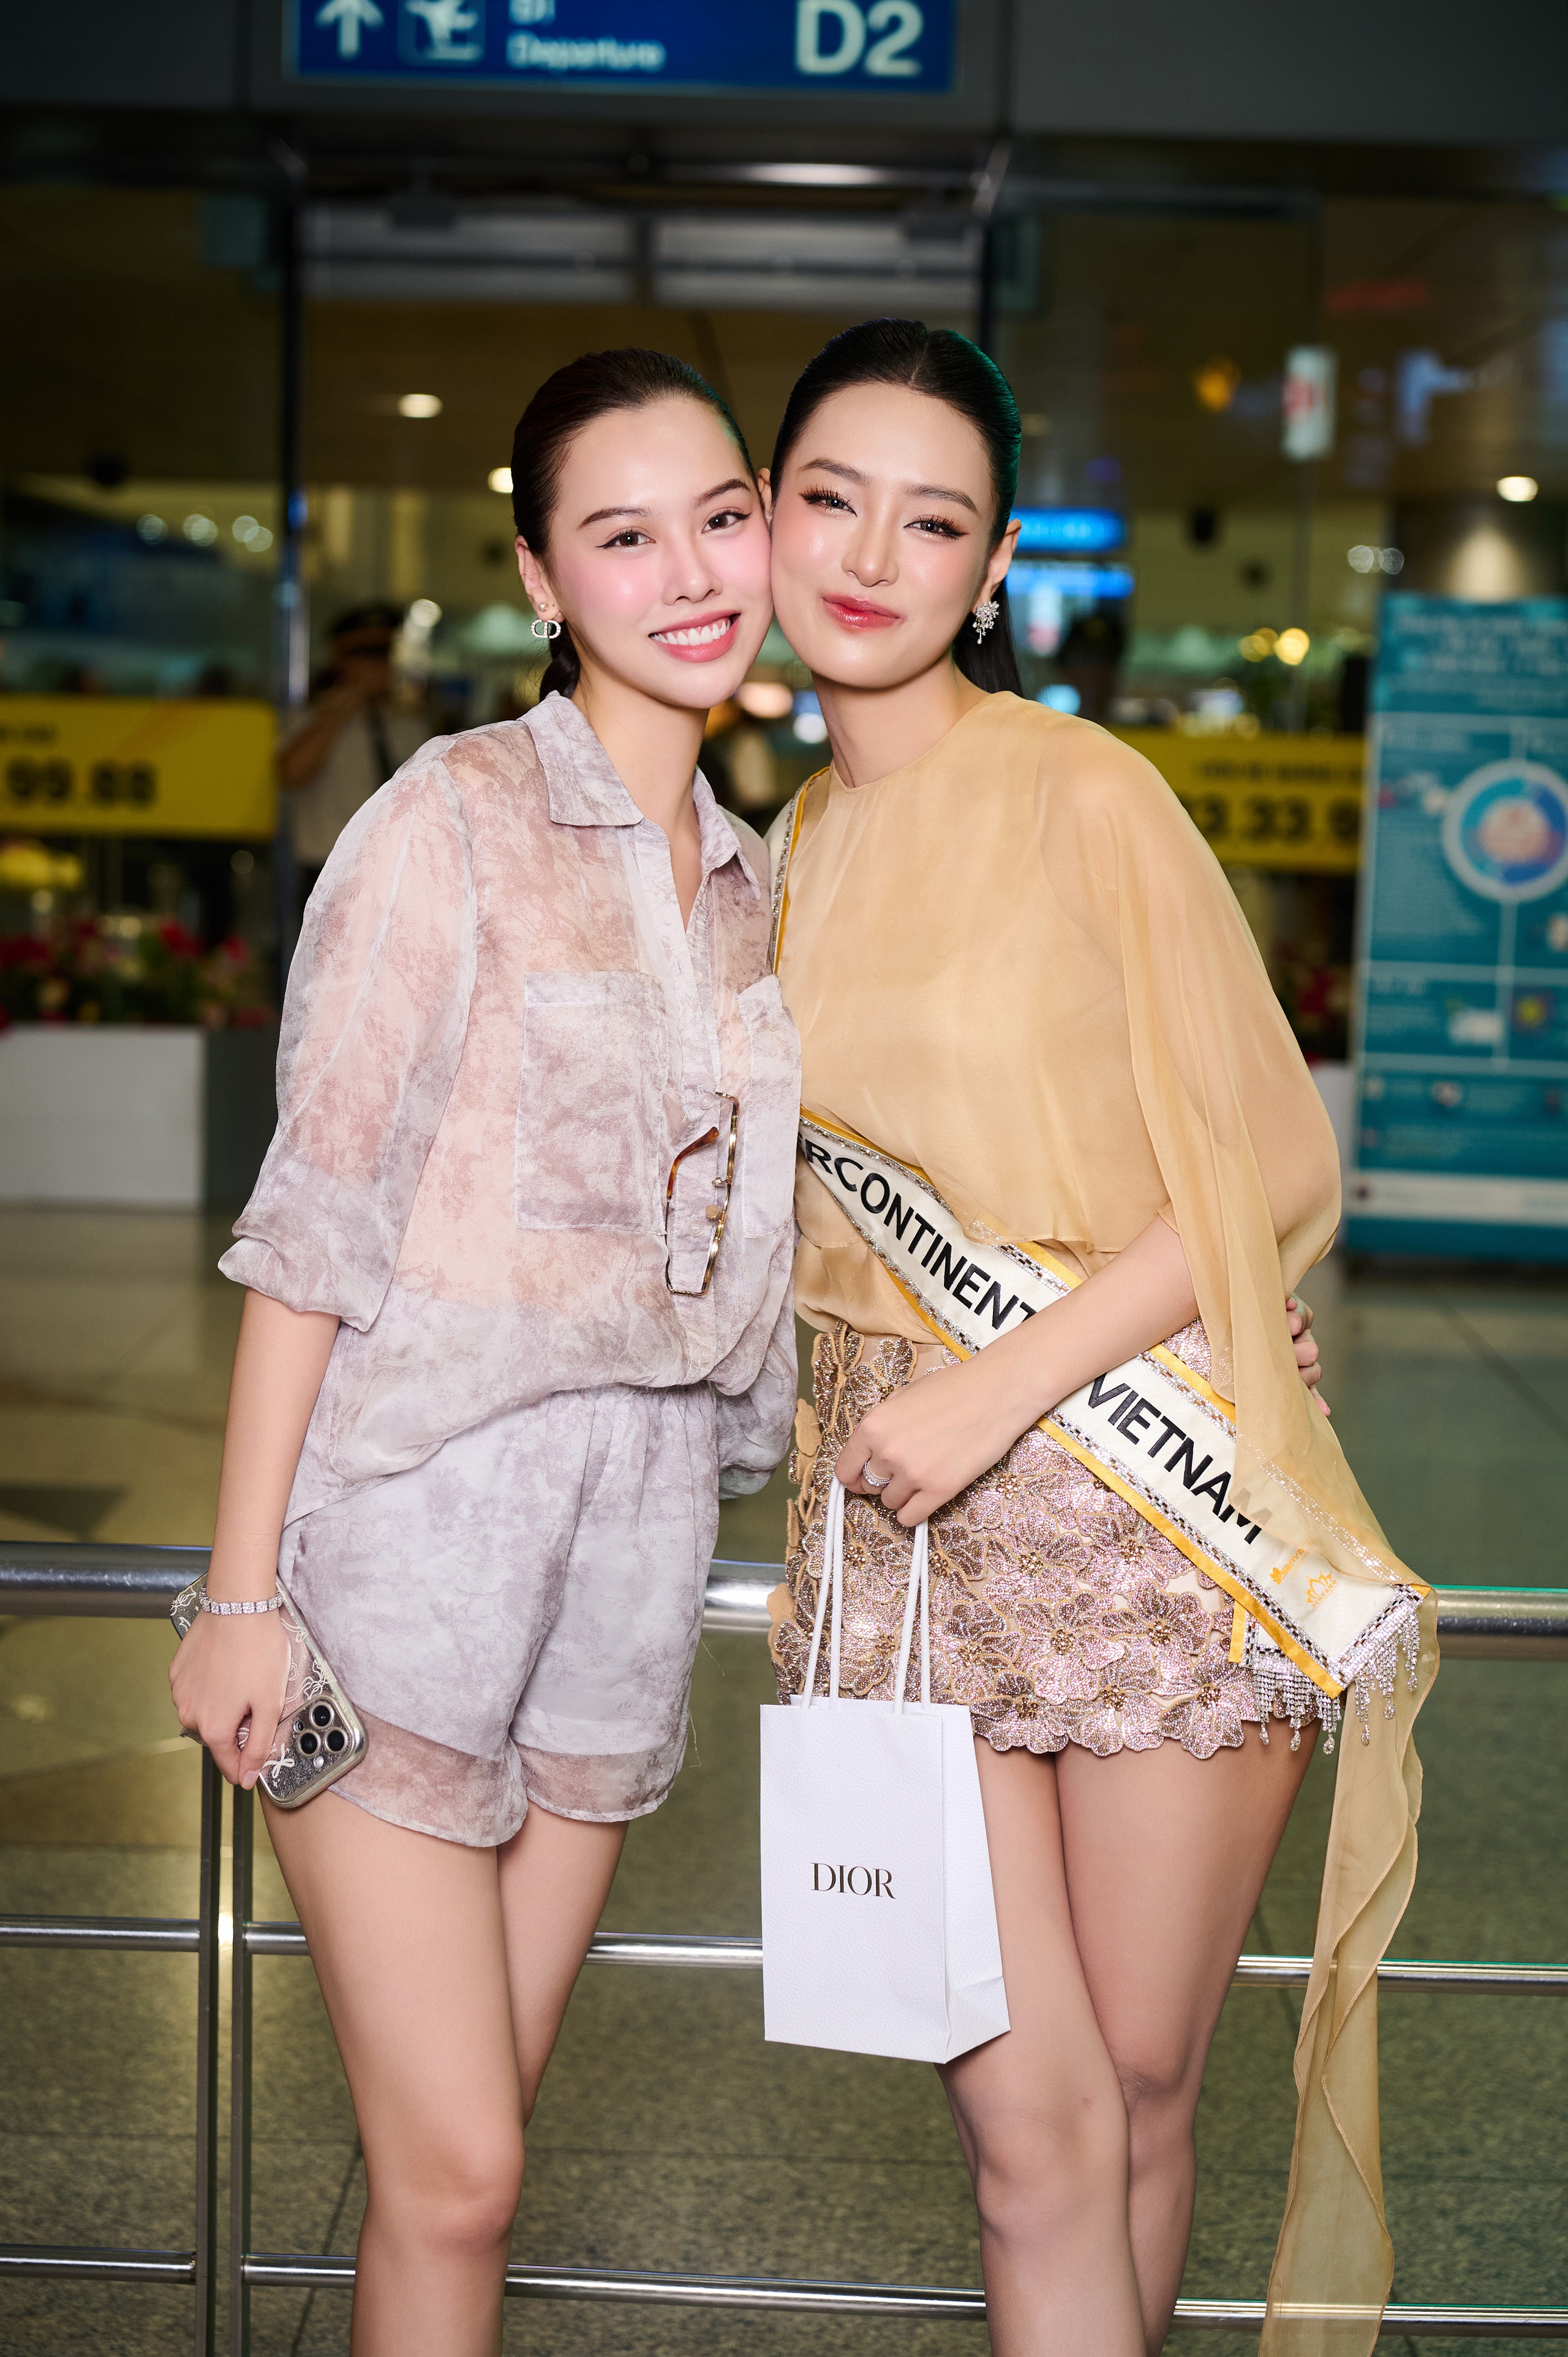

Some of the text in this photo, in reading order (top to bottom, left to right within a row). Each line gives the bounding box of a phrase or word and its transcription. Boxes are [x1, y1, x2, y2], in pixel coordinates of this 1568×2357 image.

[795, 0, 924, 77] D2
[798, 1131, 1274, 1544] RCONTINENT VIETNAM
[1312, 1579, 1337, 1608] SENVANG
[810, 1862, 897, 1899] DIOR
